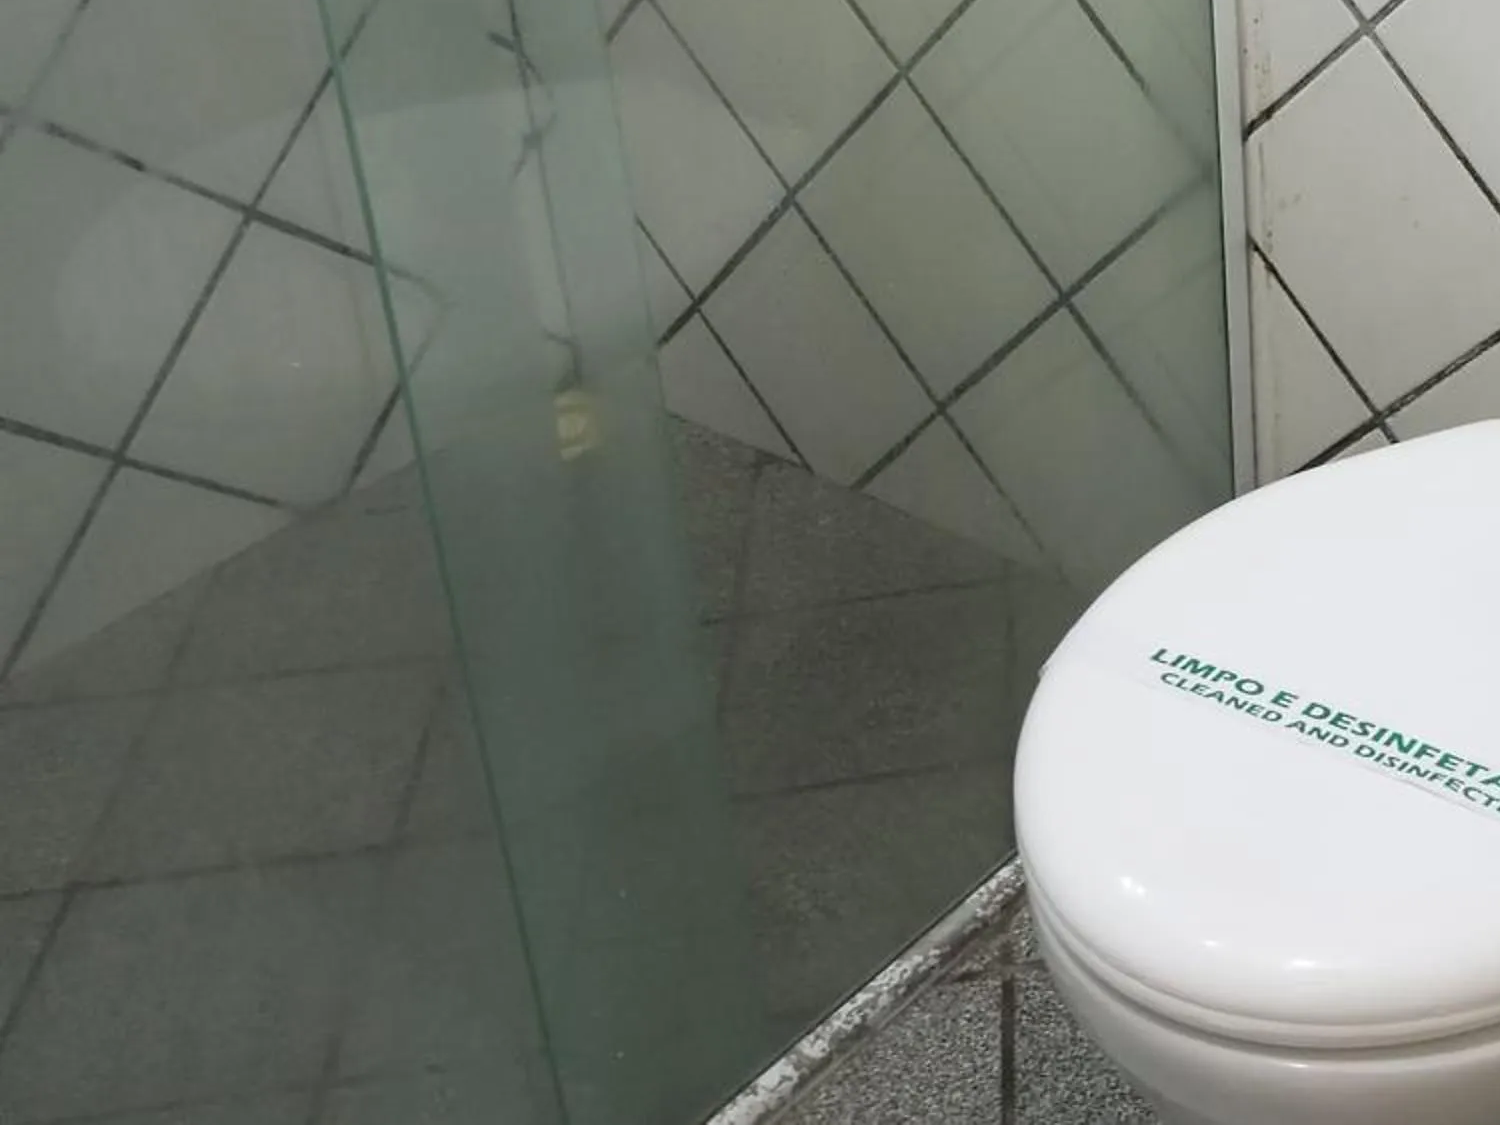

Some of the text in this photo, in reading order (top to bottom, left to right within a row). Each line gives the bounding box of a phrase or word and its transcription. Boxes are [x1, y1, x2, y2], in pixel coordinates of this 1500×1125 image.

[1150, 648, 1264, 696] LIMPO
[1271, 691, 1299, 708] E
[1160, 672, 1283, 722] CLEANED
[1285, 720, 1350, 748] AND
